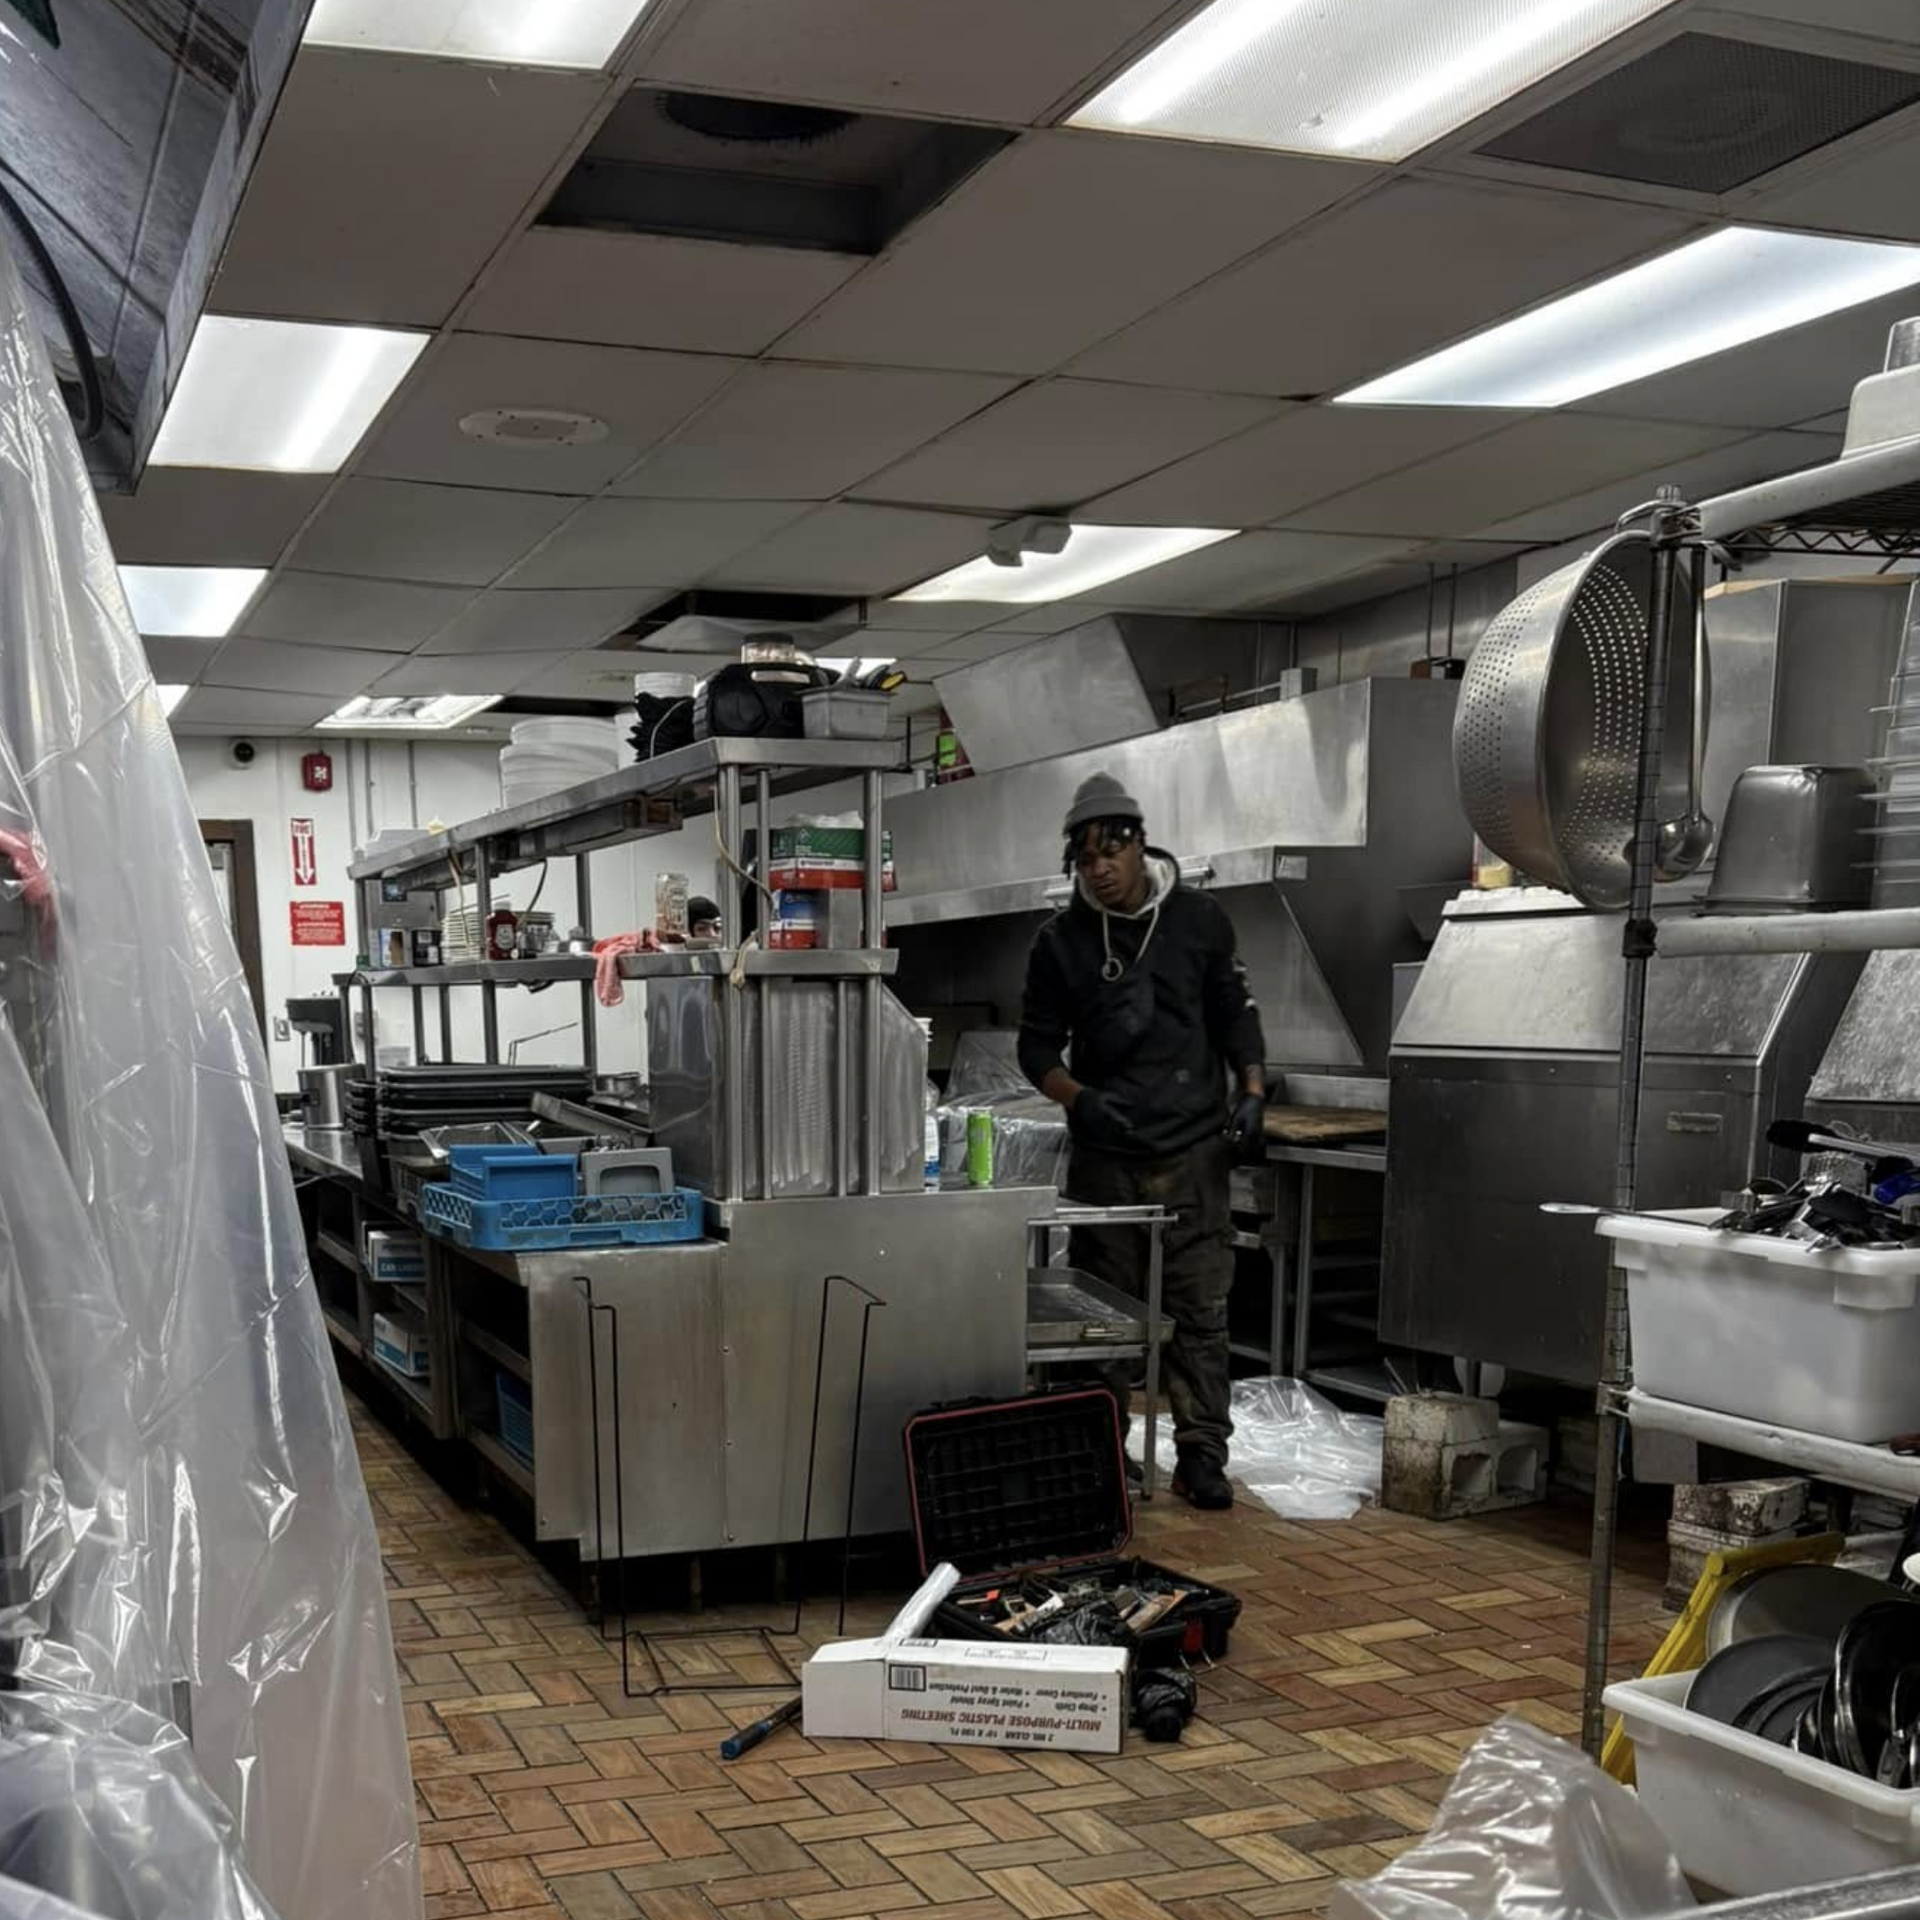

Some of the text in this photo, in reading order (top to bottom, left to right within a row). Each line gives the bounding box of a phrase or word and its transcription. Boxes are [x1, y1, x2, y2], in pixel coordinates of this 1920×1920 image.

[928, 1682, 970, 1693] Protection
[977, 1696, 1000, 1707] Spray
[1001, 1699, 1024, 1708] Paint
[901, 1708, 1102, 1731] MULTI-PURPOSE PLASTIC SHEETING
[1005, 1730, 1031, 1741] CLEAR
